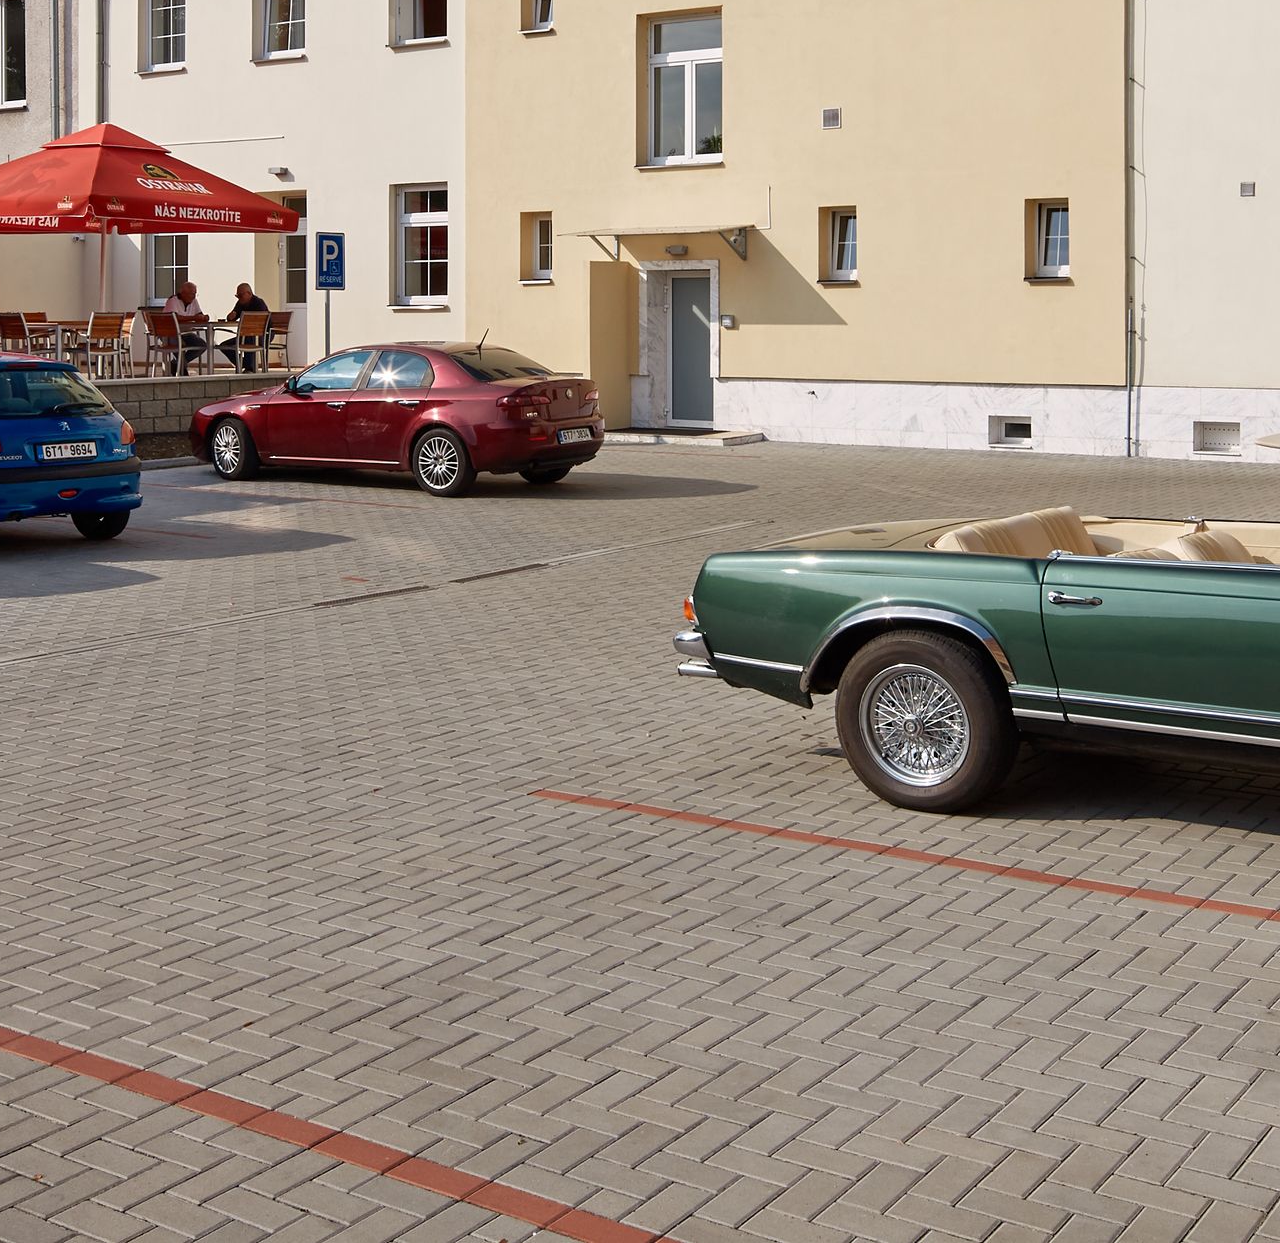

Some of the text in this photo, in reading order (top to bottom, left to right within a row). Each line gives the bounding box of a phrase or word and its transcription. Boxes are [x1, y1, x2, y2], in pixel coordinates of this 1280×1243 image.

[136, 177, 214, 195] OSTRAVAR
[154, 202, 241, 223] NÁS NEZKROTÍTE
[323, 240, 339, 271] P
[45, 443, 93, 458] 6T1 9694
